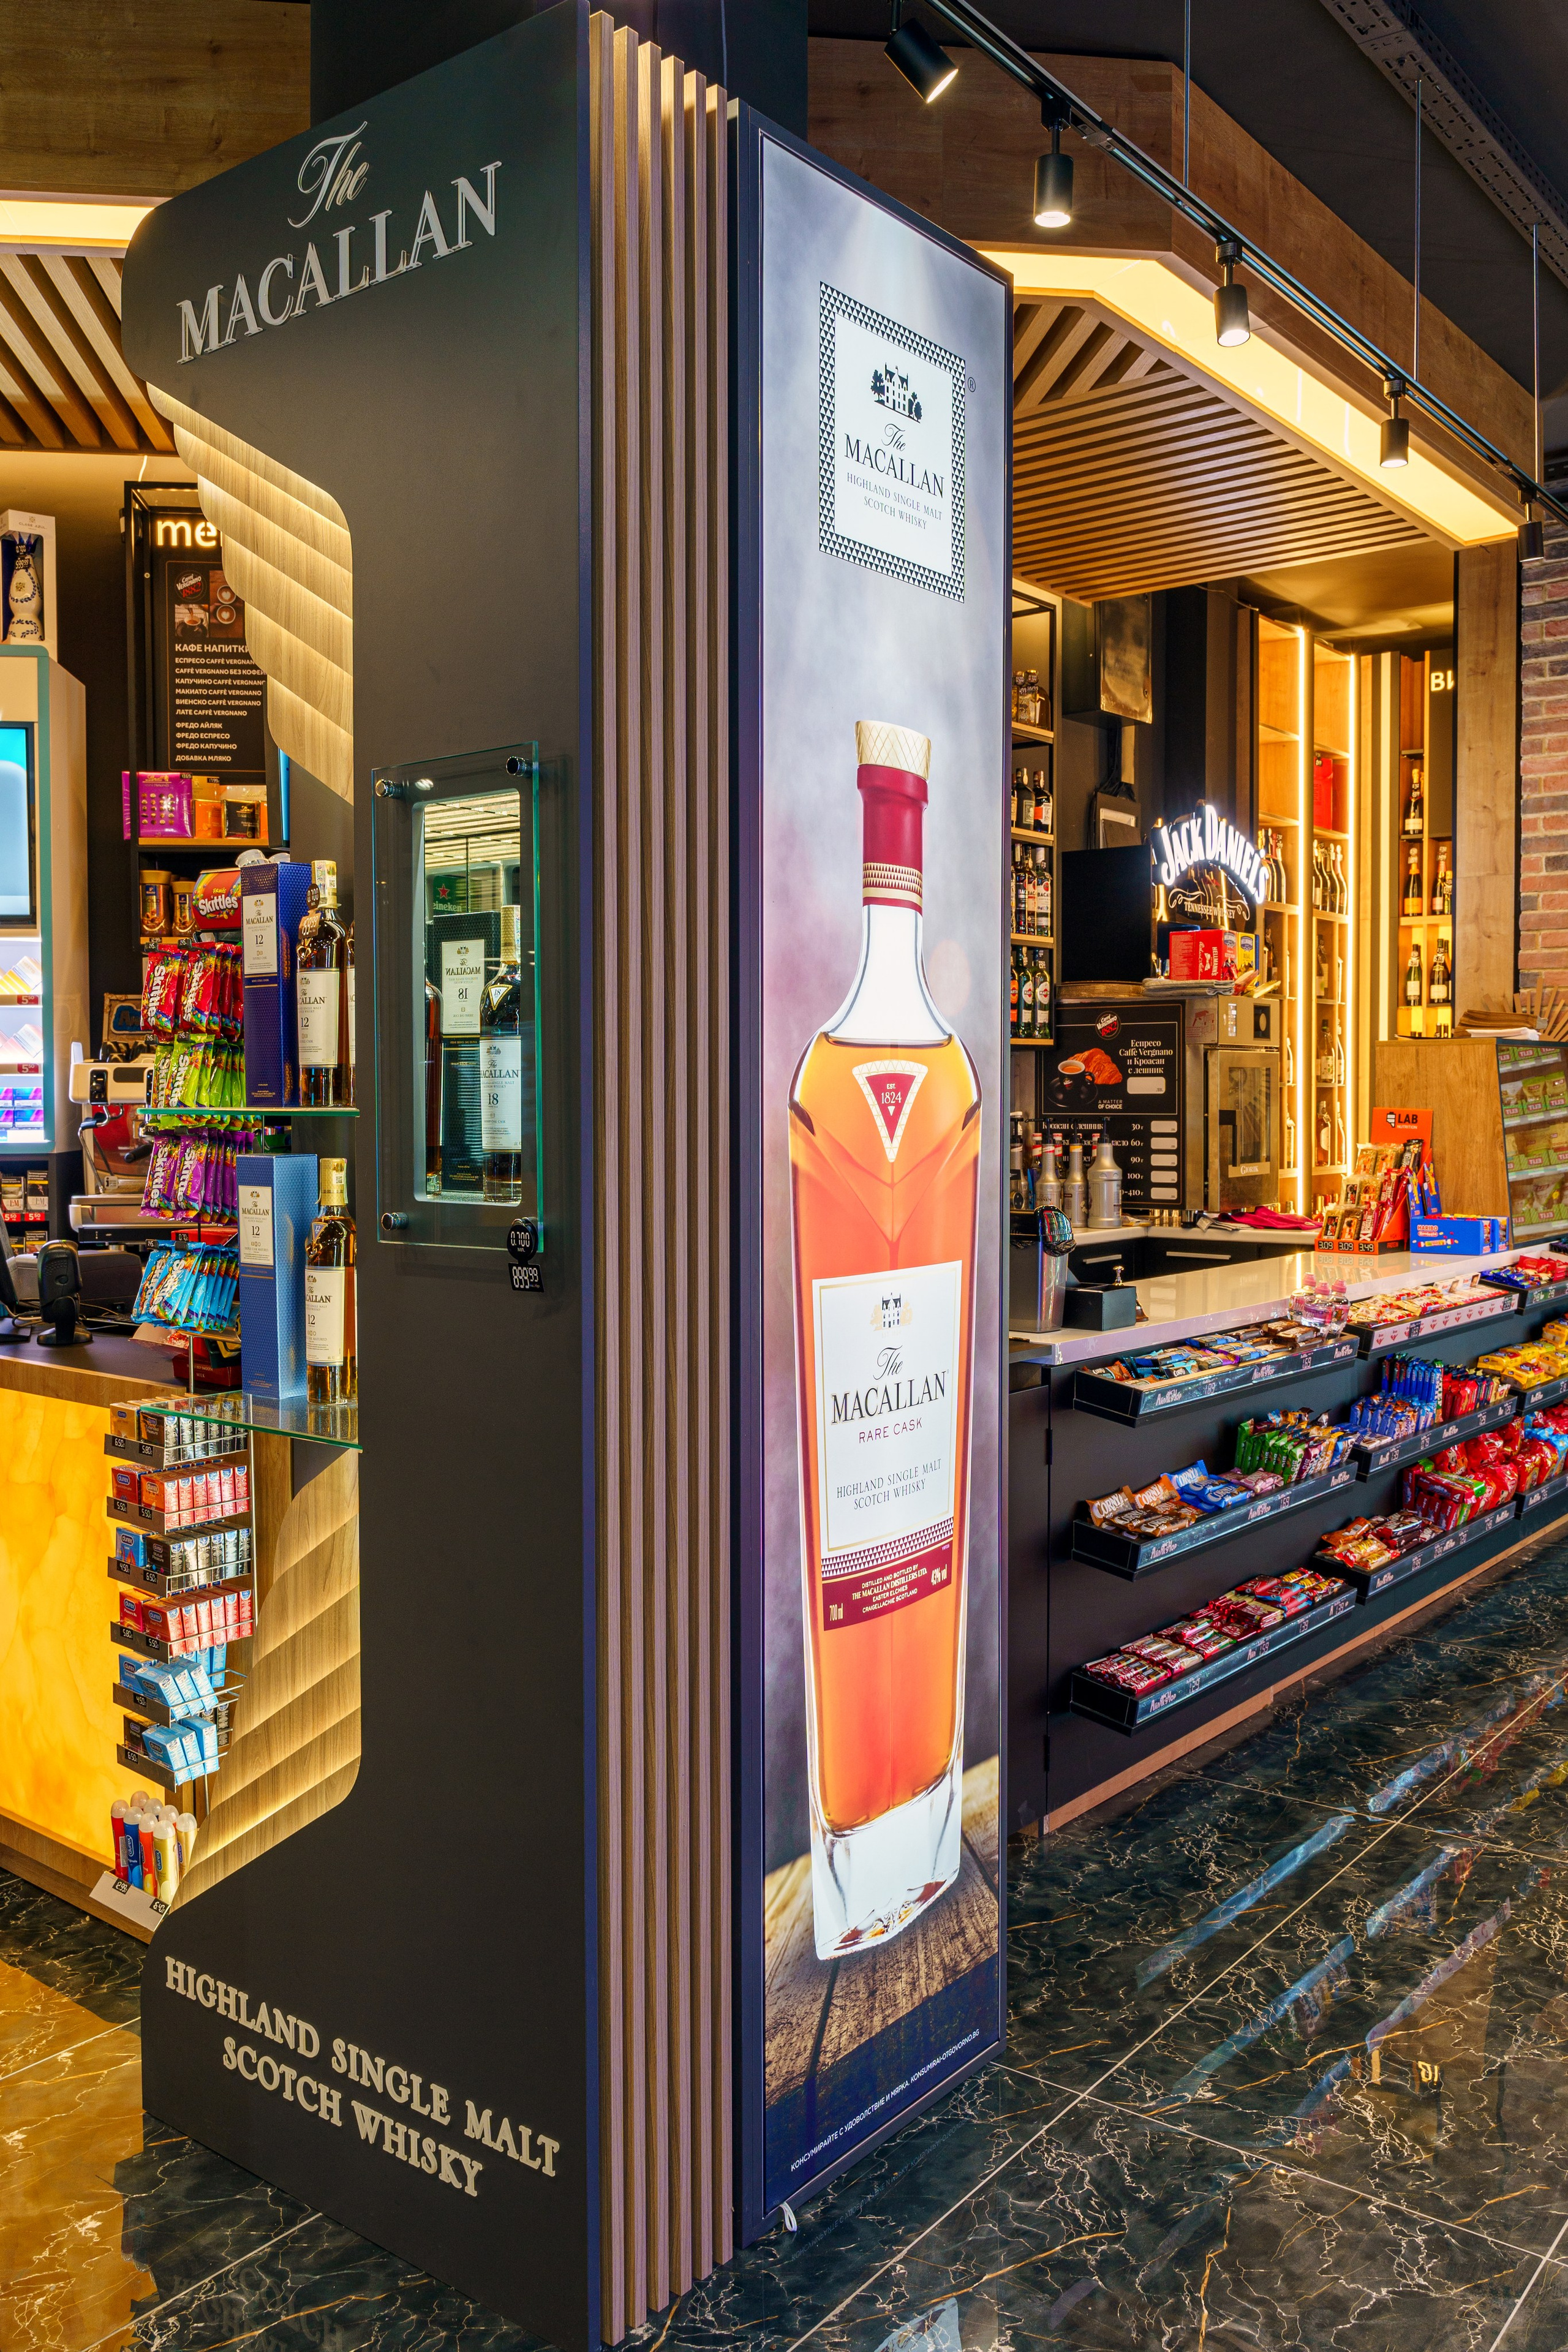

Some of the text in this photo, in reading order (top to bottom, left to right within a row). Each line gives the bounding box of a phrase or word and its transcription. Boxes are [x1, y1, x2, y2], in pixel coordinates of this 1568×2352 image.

[288, 121, 369, 227] The
[177, 161, 502, 364] MACALLAN
[881, 423, 906, 451] The
[844, 434, 944, 499] MACALLAN
[847, 472, 943, 521] HIGHLAND SINGLE MALT
[864, 496, 927, 529] SCOTCH WHISKY
[157, 521, 222, 546] me
[176, 576, 202, 590] VERGNANO
[183, 582, 201, 597] 1882
[1161, 805, 1269, 903] JACK DANIEL'S
[198, 894, 238, 915] Skittles
[433, 902, 462, 912] eineken
[1184, 902, 1235, 919] TENNESSEE WHIKEY
[246, 916, 273, 925] MACALLAN
[255, 935, 263, 944] 12
[148, 965, 166, 1027] Skittles
[301, 1017, 309, 1027] 12
[1097, 1016, 1117, 1030] VERGNANO
[1101, 1022, 1117, 1036] 1882
[1139, 1049, 1173, 1057] Vergnano
[487, 1060, 497, 1069] The
[488, 1093, 499, 1105] 18
[881, 1091, 902, 1104] 1824
[1398, 1114, 1418, 1124] LAB
[150, 1146, 168, 1208] Skittles
[1240, 1165, 1259, 1175] GIORIK
[252, 1226, 260, 1235] 12
[511, 1232, 530, 1247] 0.700
[1318, 1241, 1374, 1252] 3.09 3.09 3.49
[307, 1314, 315, 1324] 12
[873, 1345, 903, 1380] The
[831, 1370, 946, 1425] MACALLAN
[859, 1417, 922, 1444] RARE CASK
[837, 1458, 942, 1499] HIGHLAND SINGLE MALT
[1177, 1468, 1201, 1488] CORNY
[854, 1479, 926, 1510] SCOTCH WHISKY
[1134, 1483, 1163, 1509] CORNY
[1093, 1493, 1123, 1518] CORNY
[122, 1536, 134, 1544] durex
[852, 1567, 927, 1600] THE MACALLAN DISTILLERS LTD.
[862, 1577, 883, 1588] DISTILLED
[894, 1567, 912, 1579] BOTTLED
[913, 1564, 918, 1572] BY
[931, 1567, 941, 1586] 43%
[862, 1588, 918, 1613] CRAIGELLACHIE SCOTLAND
[873, 1585, 908, 1602] EASTER ELCHIES
[124, 1601, 135, 1610] durex
[838, 1603, 843, 1619] ml
[149, 1612, 161, 1621] durex
[165, 1956, 559, 2176] HIGHLAND SINGLE MALT
[791, 2132, 839, 2172] КОНСУМИРАЙТЕ
[844, 2097, 885, 2133] УДОВОЛСТВИЕ
[886, 2094, 890, 2102] И
[891, 2082, 910, 2099] МЯРКА.
[911, 2029, 979, 2084] KONSUMIRAI-OTGOVORNO.BG
[223, 2037, 482, 2196] SCOTCH WHISKY
